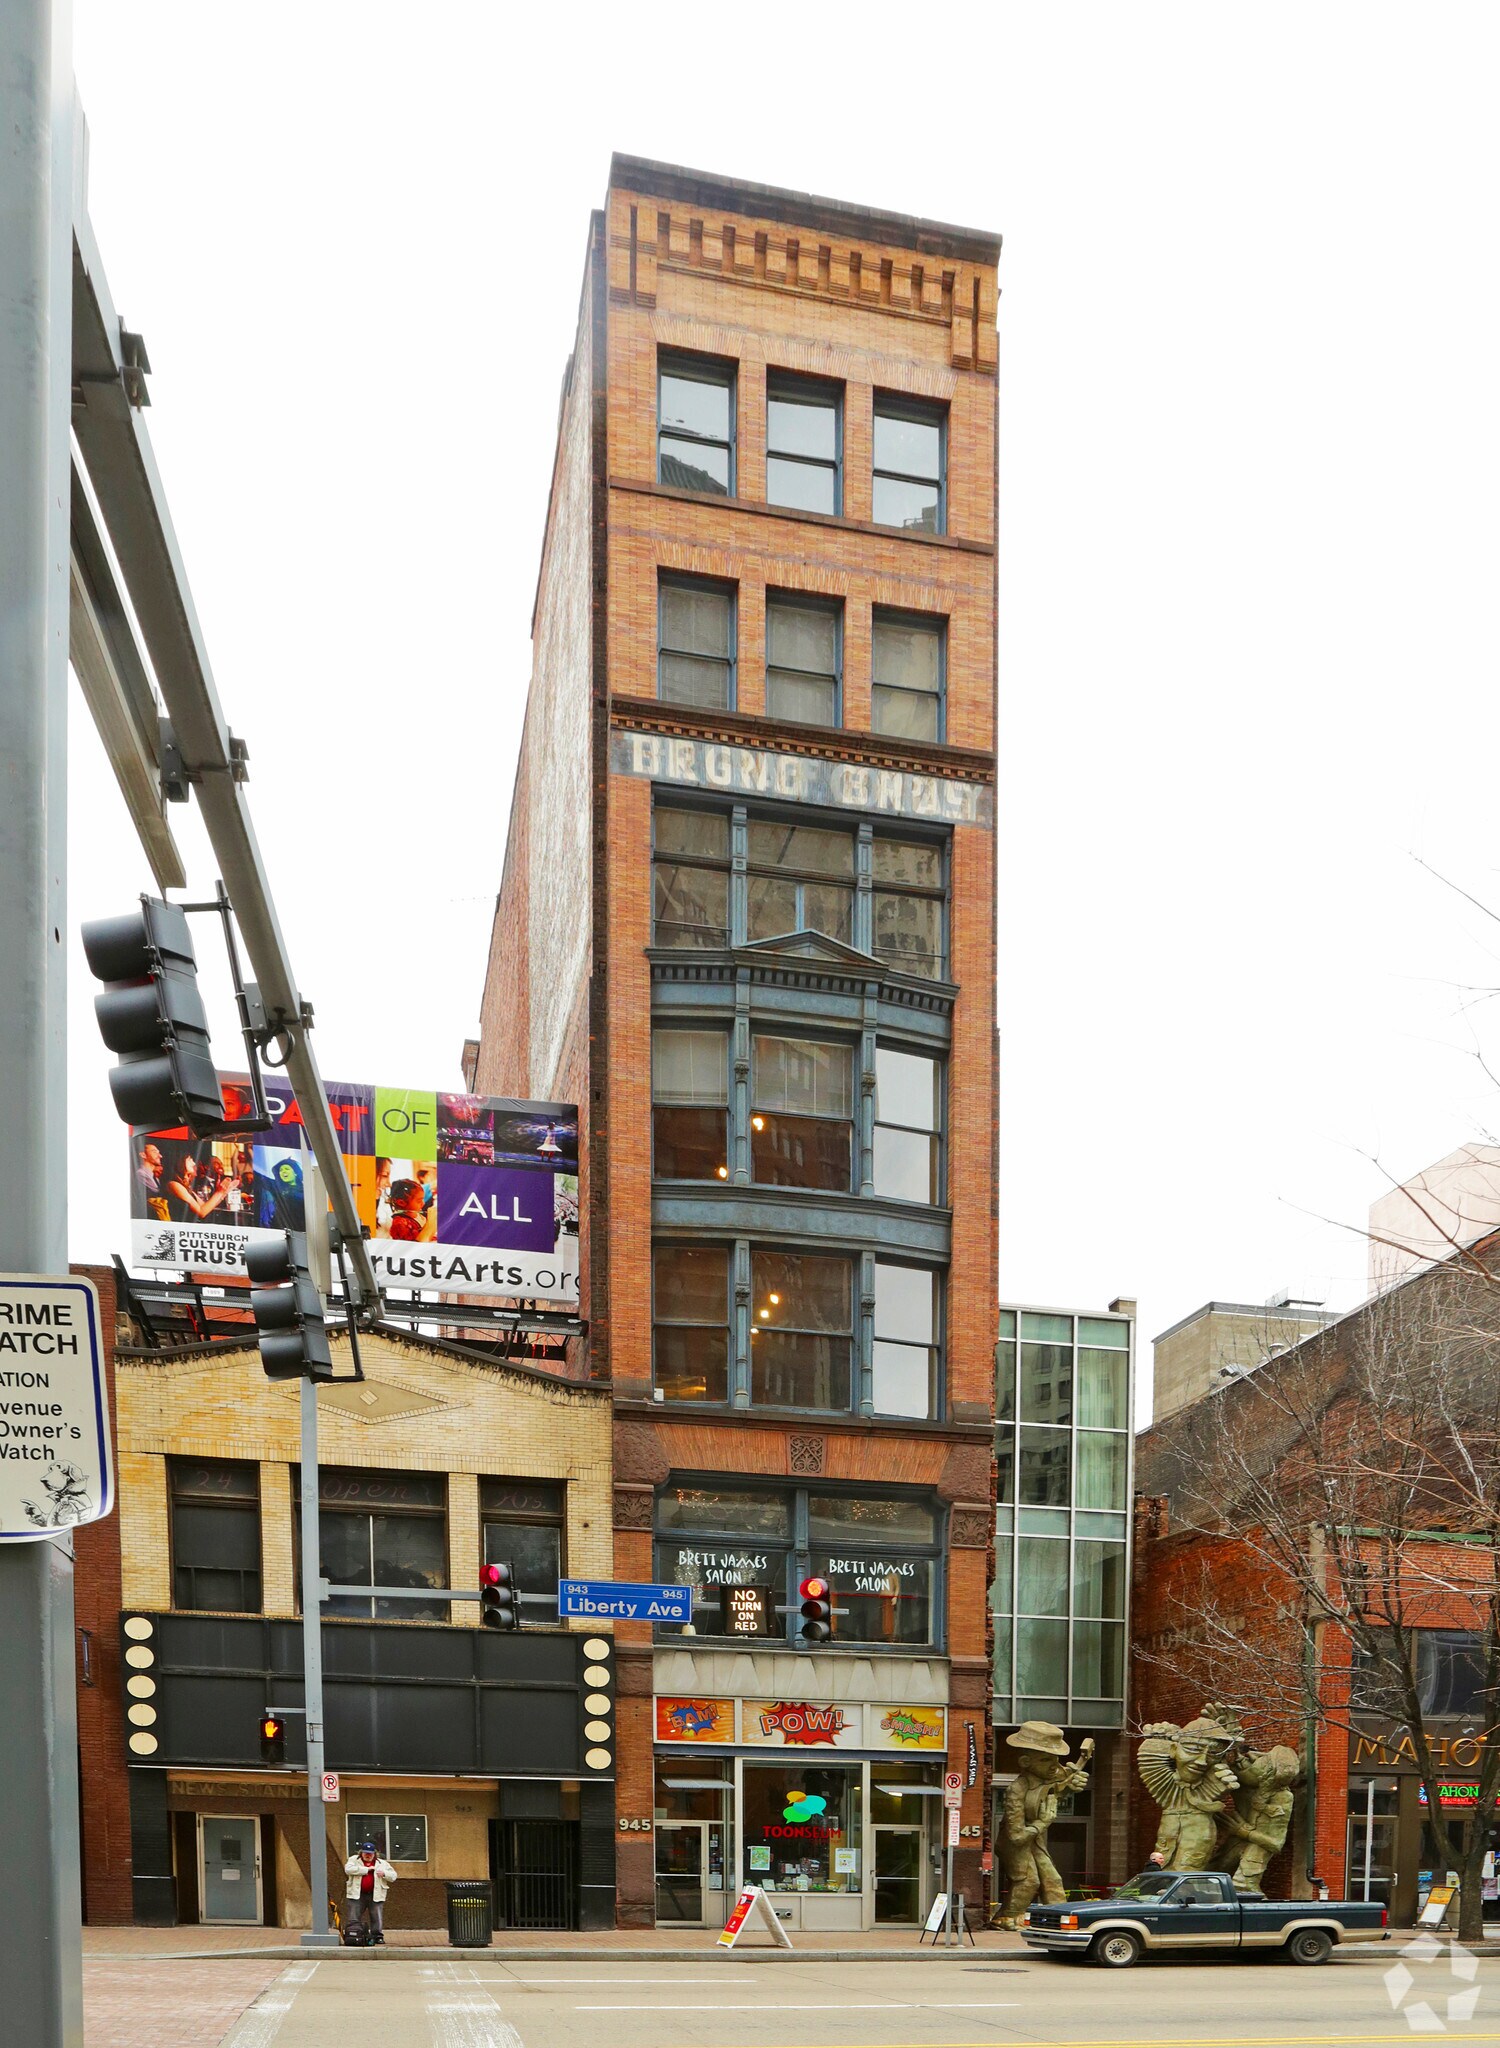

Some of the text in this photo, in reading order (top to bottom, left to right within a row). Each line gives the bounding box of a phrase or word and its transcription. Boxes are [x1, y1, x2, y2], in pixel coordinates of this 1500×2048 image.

[382, 1108, 431, 1134] OF
[459, 1192, 533, 1223] ALL
[179, 1230, 249, 1242] PITTSBURGH
[179, 1249, 246, 1266] TRUST
[0, 1303, 73, 1326] RIME
[0, 1331, 78, 1355] ATCH
[0, 1402, 63, 1416] venue
[0, 1420, 82, 1439] Owner's
[321, 1478, 410, 1500] Open
[678, 1550, 768, 1571] BRETT JAMES
[829, 1558, 915, 1577] BRETT JAMES
[706, 1568, 742, 1585] SALON
[855, 1576, 891, 1592] SALON
[567, 1585, 683, 1599] 943 945
[734, 1590, 757, 1601] NO
[567, 1597, 683, 1617] Liberty Ave
[730, 1602, 762, 1611] TURN
[737, 1612, 755, 1621] ON
[734, 1621, 758, 1631] RED
[670, 1704, 720, 1729] BAM!
[759, 1709, 845, 1737] POW!
[880, 1718, 941, 1738] SMASH!
[1352, 1734, 1484, 1768] MAHO
[171, 1780, 226, 1797] NEWS
[1438, 1785, 1479, 1797] AHON
[618, 1818, 652, 1831] 945
[762, 1825, 841, 1839] TOONSEUM
[960, 1825, 981, 1837] 45
